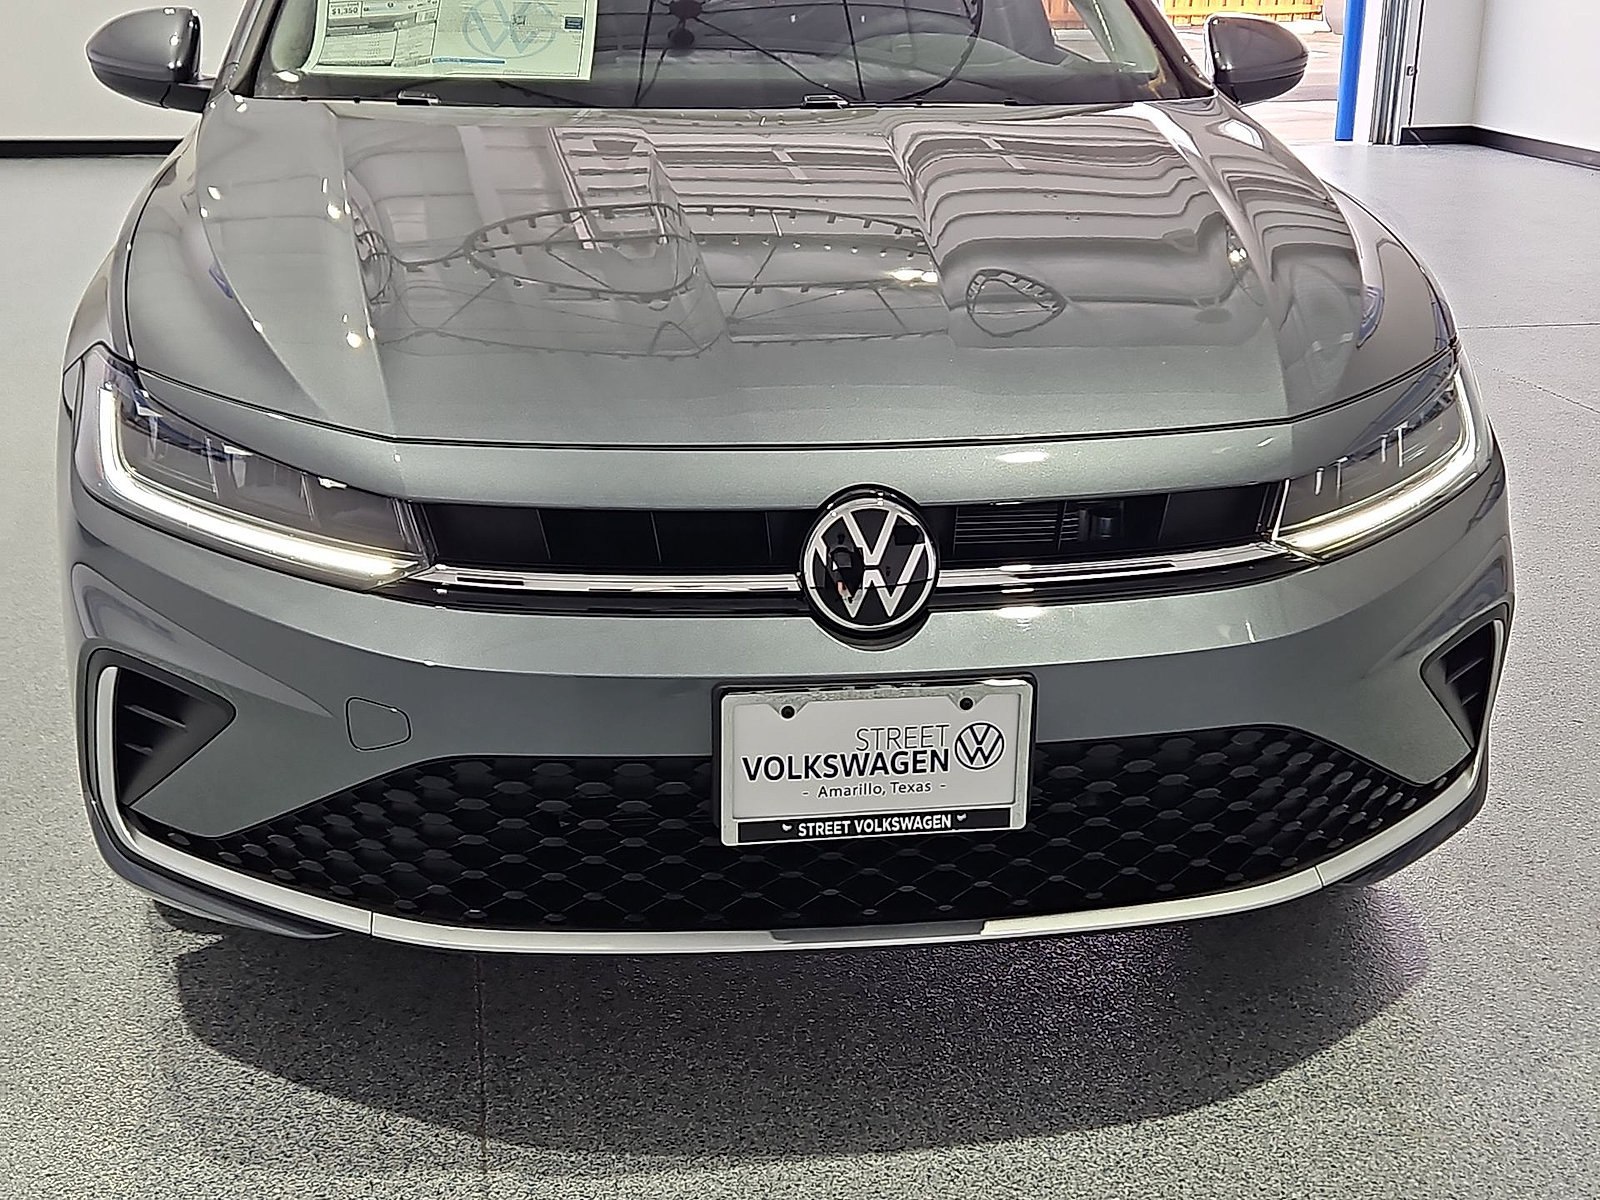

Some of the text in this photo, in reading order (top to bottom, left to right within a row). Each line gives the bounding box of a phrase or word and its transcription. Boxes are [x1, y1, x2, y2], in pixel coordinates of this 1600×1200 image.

[855, 723, 950, 751] STREET
[741, 748, 950, 781] VOLKSWAGEN
[817, 780, 932, 798] Amarillo, Texas
[798, 813, 951, 837] STREET VOLKSWAGEN
